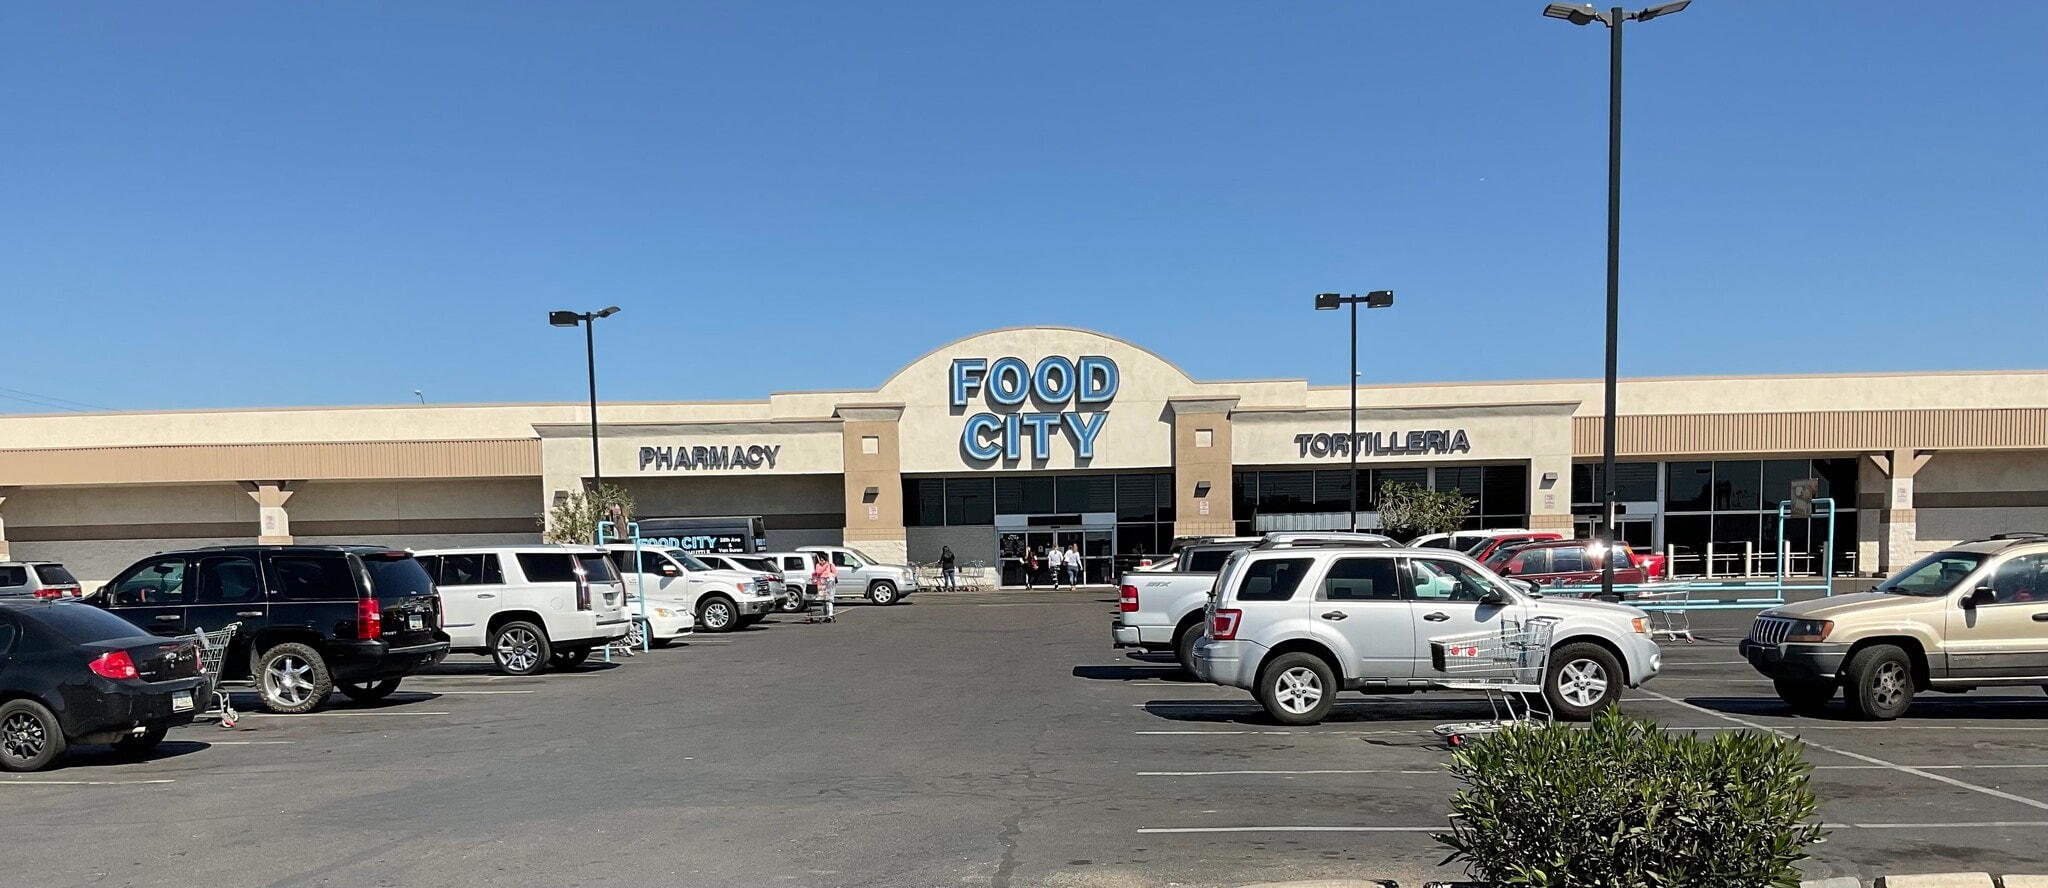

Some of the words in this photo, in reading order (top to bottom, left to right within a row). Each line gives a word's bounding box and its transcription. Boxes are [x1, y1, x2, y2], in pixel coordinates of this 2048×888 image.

[951, 355, 1120, 408] FOOD
[962, 411, 1110, 463] CITY
[1294, 430, 1470, 458] TORTILLERIA
[639, 445, 781, 471] PHARMACY
[681, 536, 717, 549] CITY
